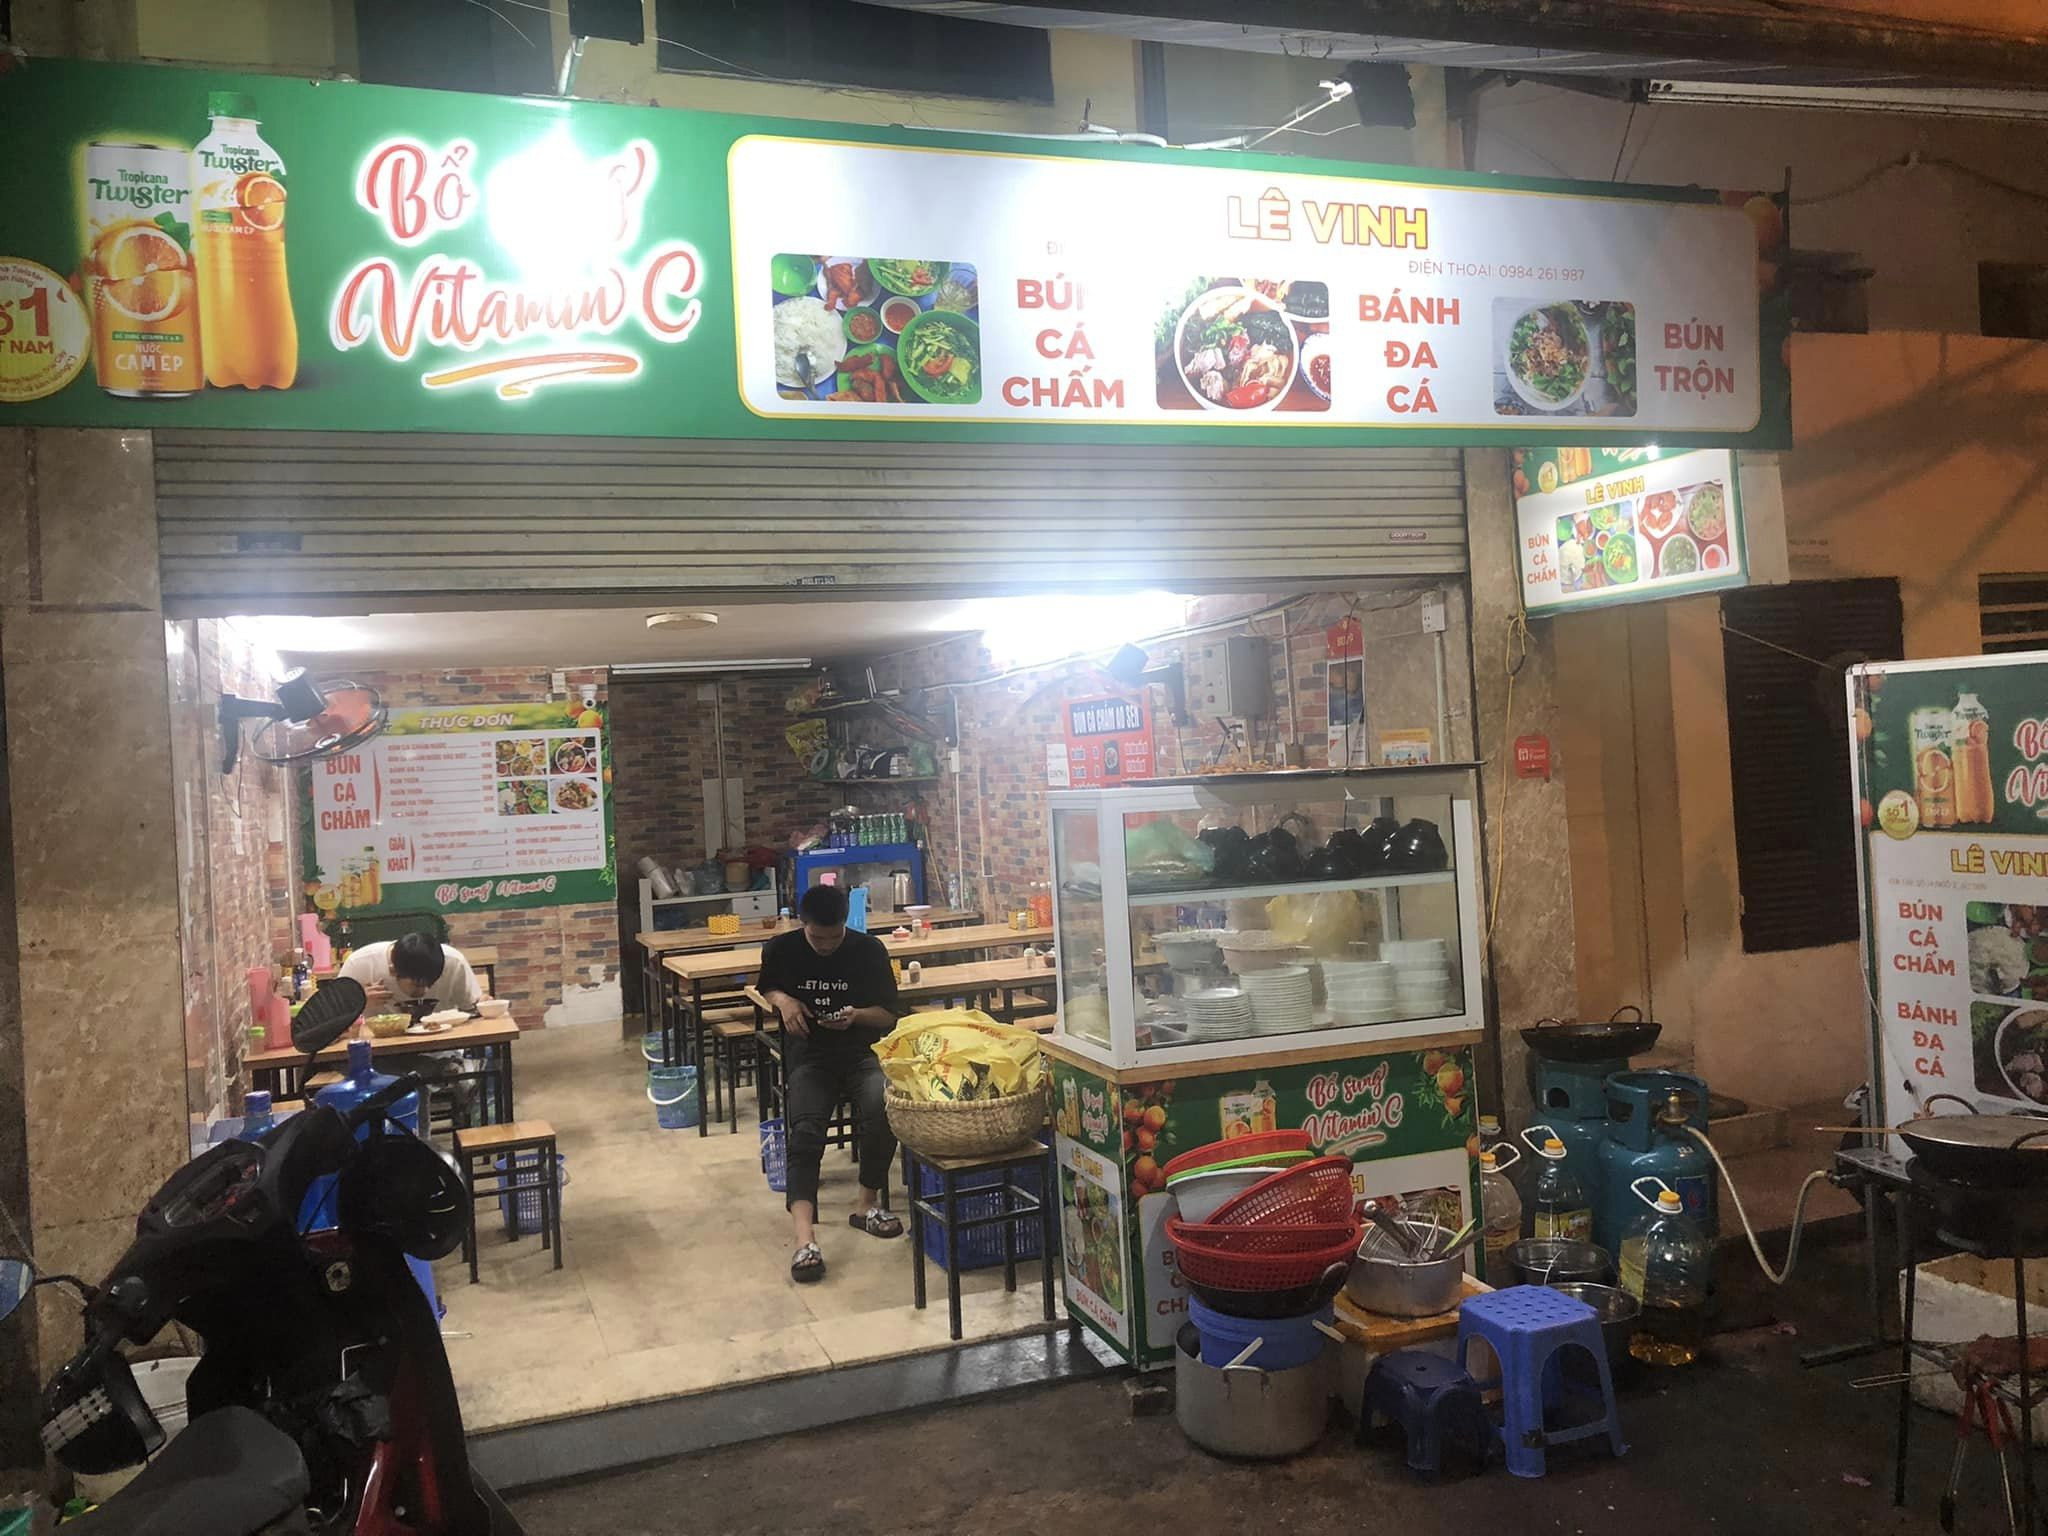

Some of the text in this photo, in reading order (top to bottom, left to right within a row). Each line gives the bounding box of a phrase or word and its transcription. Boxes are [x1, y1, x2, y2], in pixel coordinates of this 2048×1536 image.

[198, 150, 275, 175] Twister
[220, 143, 260, 156] Tropicana
[117, 168, 169, 185] Tropicana
[88, 177, 190, 209] Twister
[365, 143, 472, 240] Bổ
[1227, 186, 1429, 249] LÊ VINH
[1498, 264, 1533, 279] 0984
[1537, 267, 1558, 281] 261
[1562, 268, 1585, 281] 987
[338, 250, 697, 357] Vitamin C
[1358, 288, 1460, 325] BÁNH
[1035, 321, 1096, 360] CÁ
[1663, 316, 1724, 351] BÚN
[10, 340, 54, 354] NAM
[1383, 340, 1438, 369] ĐA
[114, 354, 157, 371] CAM
[1002, 364, 1125, 408] CHẤM
[1654, 359, 1735, 400] TRỘN
[1386, 375, 1438, 413] CÁ
[1585, 475, 1645, 505] LÊ VINH
[1527, 532, 1550, 549] BÚN
[1532, 549, 1548, 565] CÁ
[472, 712, 514, 727] ĐƠN
[333, 777, 357, 803] CÁ
[1950, 844, 2048, 878] LÊ VIN
[1899, 900, 1943, 922] BÚN
[1908, 927, 1939, 948] CÁ
[1893, 951, 1956, 976] CHẤM
[819, 980, 830, 990] la
[831, 979, 849, 990] vie
[815, 997, 831, 1006] est
[1897, 1000, 1958, 1026] BÁNH
[1912, 1030, 1944, 1051] ĐA
[1914, 1056, 1945, 1078] CÁ
[1308, 1062, 1388, 1109] Bổ sung
[1304, 1095, 1403, 1146] Vitamin C
